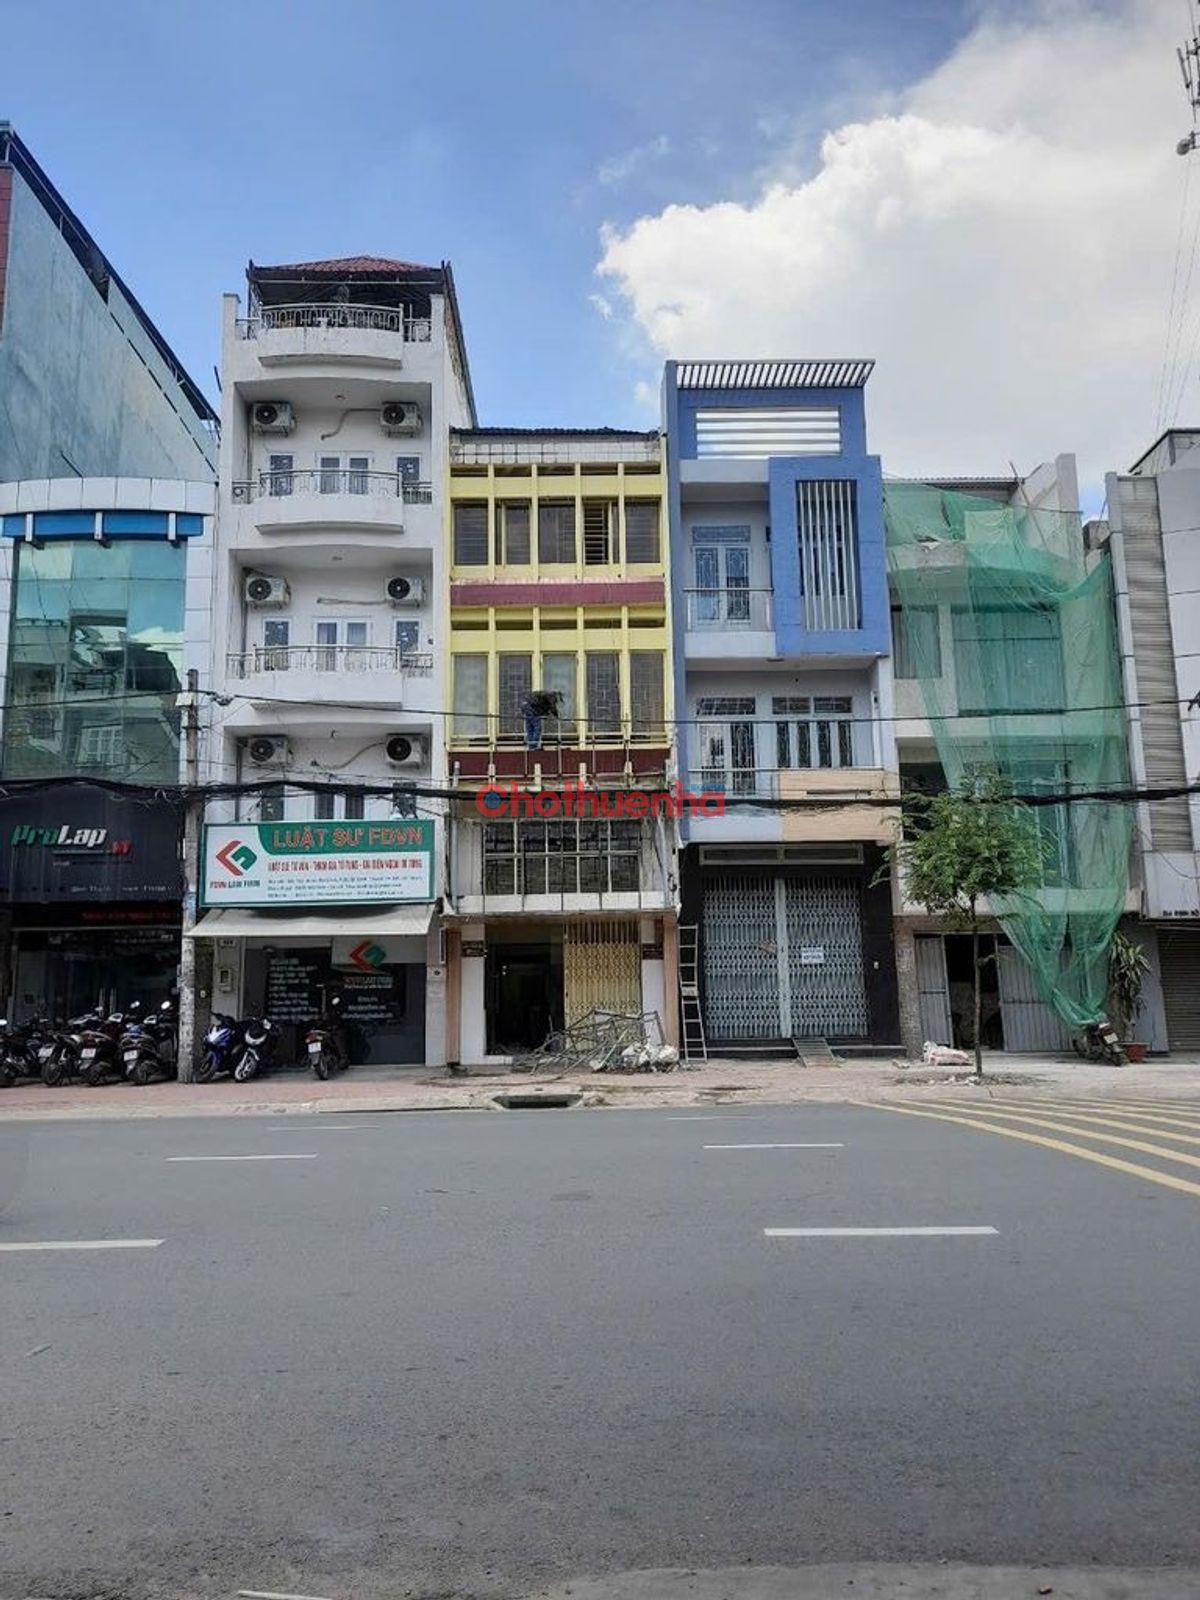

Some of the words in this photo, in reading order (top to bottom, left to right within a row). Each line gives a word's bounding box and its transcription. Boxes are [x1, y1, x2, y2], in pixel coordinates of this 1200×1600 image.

[11, 825, 107, 848] ProLap
[273, 826, 328, 850] LUẬT
[332, 827, 364, 847] SƯ
